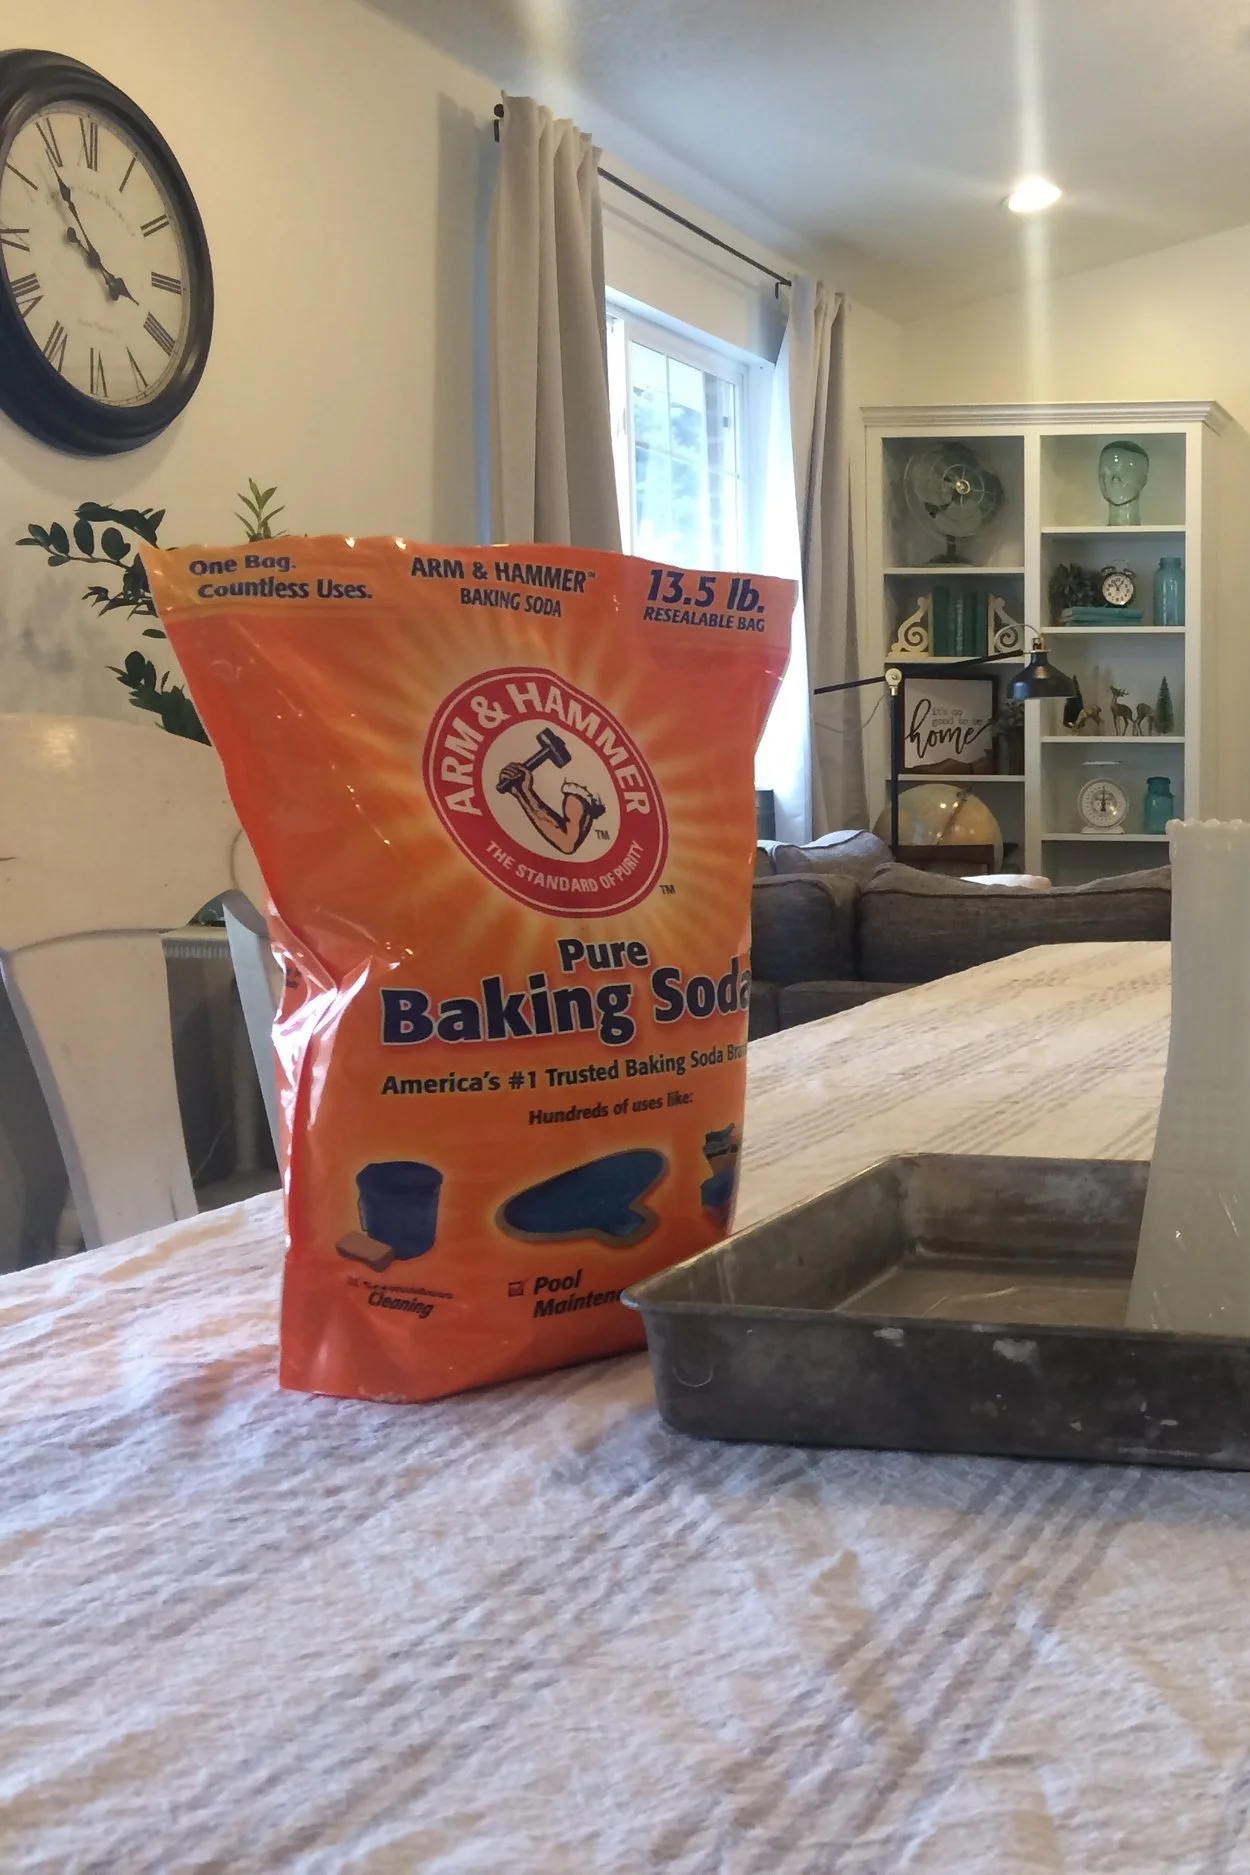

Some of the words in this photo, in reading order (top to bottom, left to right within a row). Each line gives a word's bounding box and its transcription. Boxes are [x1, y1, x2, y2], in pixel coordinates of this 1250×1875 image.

[151, 271, 182, 296] III
[189, 559, 237, 575] One
[245, 555, 296, 572] Bag.
[411, 557, 465, 580] ARM
[472, 561, 487, 580] &
[198, 576, 309, 598] Countless
[317, 578, 373, 599] Uses.
[460, 587, 521, 611] BAKING
[524, 595, 562, 618] SODA
[647, 569, 716, 607] 13.5
[727, 577, 765, 613] lb.
[643, 606, 735, 629] RESEALABLE
[737, 616, 765, 632] BAG
[904, 698, 992, 759] home
[441, 716, 484, 817] ARM
[470, 695, 513, 729] &
[505, 681, 650, 816] HAMMER
[486, 840, 513, 870] THE
[515, 863, 599, 893] STANDARD
[601, 874, 614, 889] OF
[614, 840, 644, 882] PURITY
[556, 938, 650, 973] Pure
[380, 972, 637, 1046] Baking
[381, 1071, 501, 1095] America's
[508, 1070, 536, 1090] #1
[547, 1060, 620, 1087] Trusted
[625, 1053, 686, 1079] Baking
[690, 1046, 724, 1068] Soda
[528, 1102, 609, 1126] Hundreds
[613, 1098, 630, 1116] of
[632, 1096, 663, 1114] uses
[666, 1090, 693, 1107] like:
[533, 1269, 582, 1295] Pool
[368, 1291, 435, 1319] Cleaning
